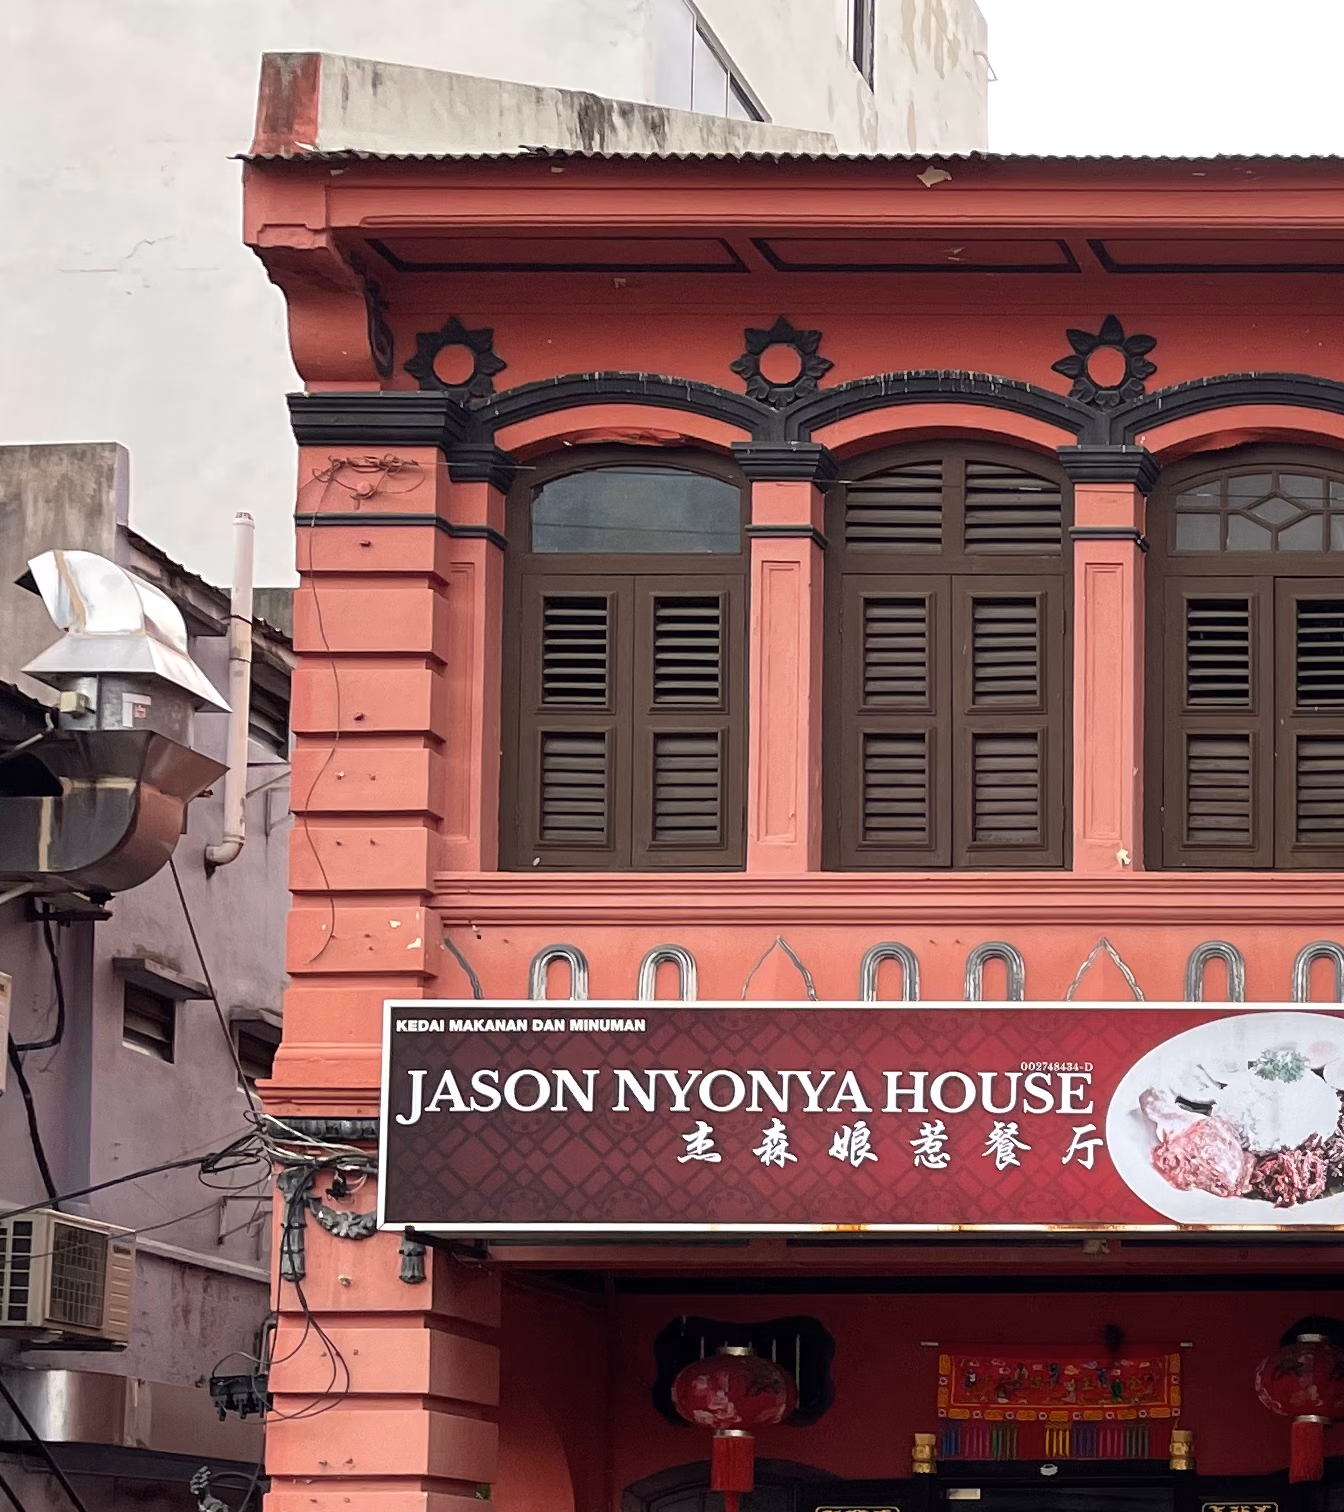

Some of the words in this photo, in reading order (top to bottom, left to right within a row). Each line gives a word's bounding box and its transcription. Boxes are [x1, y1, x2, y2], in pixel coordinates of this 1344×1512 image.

[396, 1019, 445, 1032] KEDAI
[449, 1019, 528, 1032] MAKANAN
[532, 1019, 565, 1032] DAN
[570, 1019, 646, 1032] MINUMAN
[395, 1069, 600, 1125] JASON
[612, 1069, 873, 1114] NYONYA
[881, 1070, 1094, 1115] HOUSE
[677, 1118, 1103, 1170] 杰森娘惹餐厅
